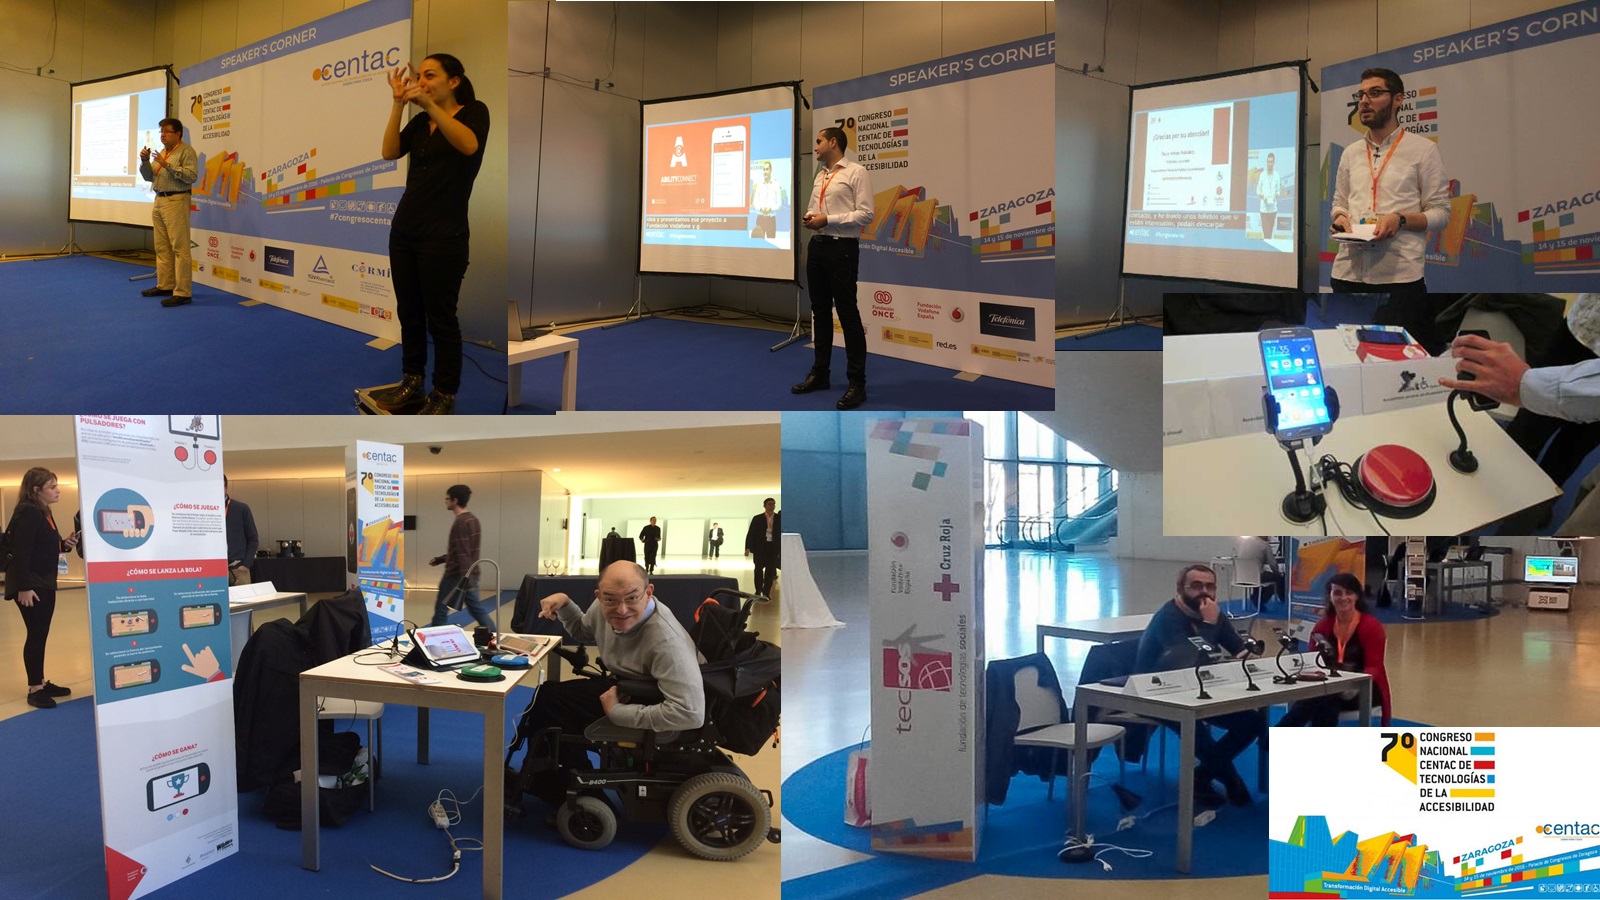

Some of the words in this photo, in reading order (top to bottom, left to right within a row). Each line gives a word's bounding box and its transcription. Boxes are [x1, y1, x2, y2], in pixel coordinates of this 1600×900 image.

[1413, 25, 1520, 63] SPEAKER'S
[1526, 6, 1598, 37] CORN
[221, 44, 268, 69] SPEAKER'S
[270, 28, 317, 53] CORNER
[321, 46, 400, 80] centac
[889, 58, 974, 87] SPEAKER'S
[203, 89, 222, 99] CONGRESO
[203, 97, 221, 107] NACIONAL
[203, 107, 216, 115] CENTAC
[858, 110, 892, 123] CONGRESO
[858, 121, 889, 133] NACIONAL
[202, 130, 230, 140] ACCESIBILIDAD
[858, 132, 882, 143] CENTAC
[882, 131, 892, 139] DE
[858, 139, 902, 152] TECNOLOGÍAS
[858, 153, 867, 162] DE
[867, 153, 876, 161] LA
[267, 152, 310, 177] ZARAGOZA
[341, 169, 364, 180] Congresos
[372, 161, 394, 171] Zaragoza
[980, 187, 1055, 218] ZARAGOZA
[1013, 229, 1045, 238] noviembre
[871, 244, 887, 253] Digital
[888, 246, 914, 255] Accesible
[1538, 242, 1547, 250] 14
[872, 304, 894, 312] Fundación
[917, 301, 941, 310] Fundación
[917, 307, 940, 315] Vodafone
[872, 310, 894, 319] ONCE
[917, 313, 935, 321] España
[988, 313, 1025, 327] Telefónica
[936, 340, 957, 351] red.es
[1266, 344, 1290, 355] 17:35
[80, 417, 126, 429] PULSADORES?
[112, 415, 133, 423] JUEGA
[366, 451, 397, 463] centac
[361, 471, 373, 485] 7º
[173, 502, 193, 511] ¿CÓMO
[939, 518, 954, 542] Roja
[939, 542, 951, 570] Cruz
[126, 568, 148, 577] ¿CÓMO
[957, 614, 967, 651] sociales
[958, 700, 967, 711] de
[151, 750, 172, 762] ¿CÓMO
[179, 743, 198, 753] GANA?
